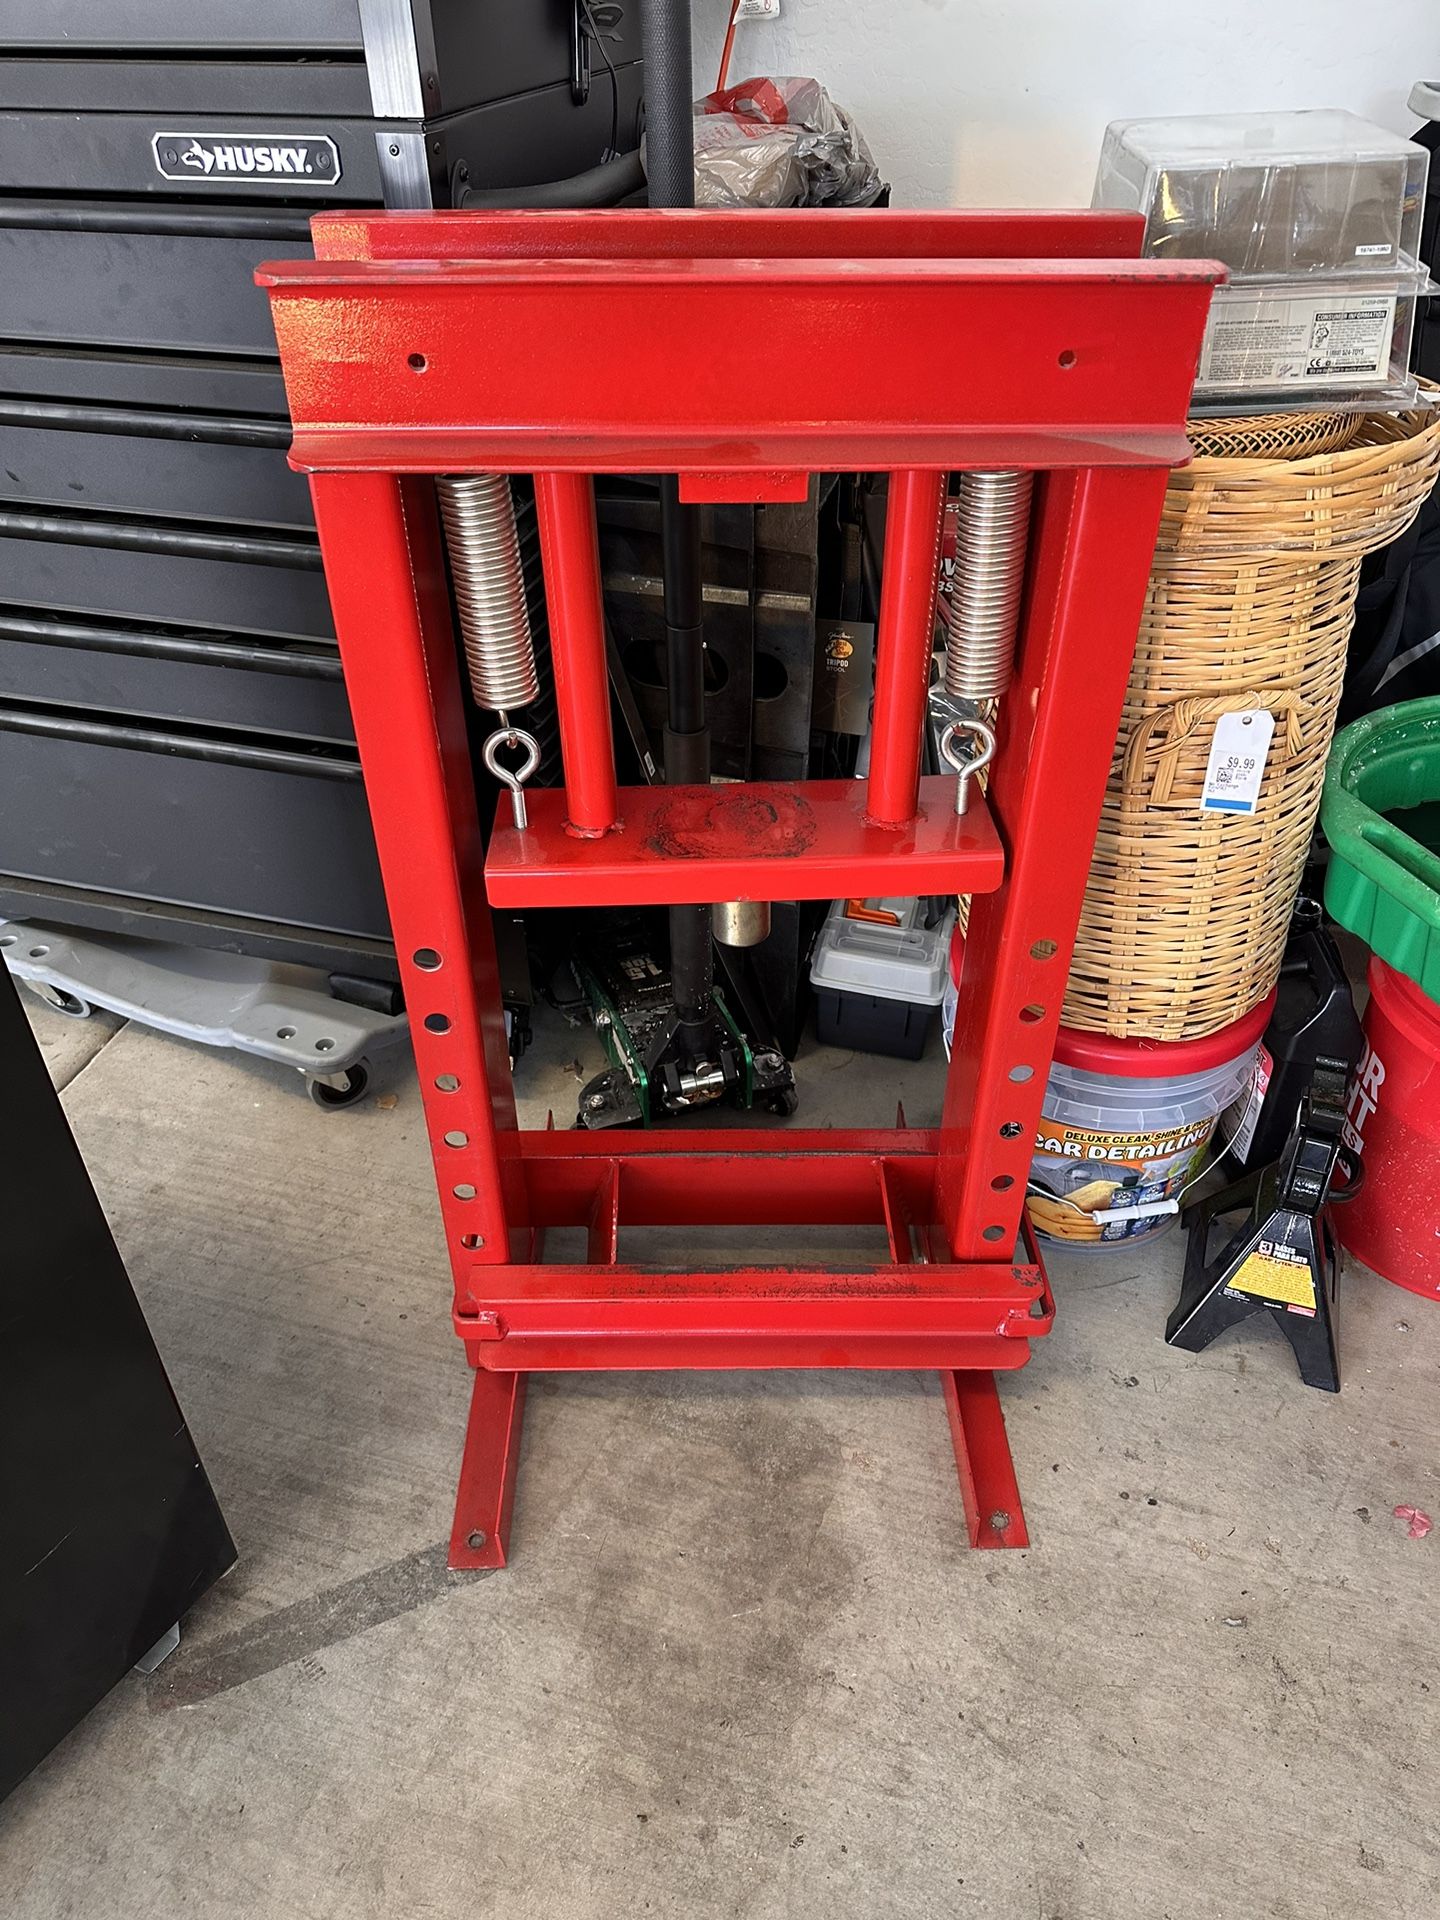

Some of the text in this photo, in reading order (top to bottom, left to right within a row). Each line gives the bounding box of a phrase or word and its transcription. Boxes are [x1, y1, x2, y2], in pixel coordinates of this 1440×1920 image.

[1349, 311, 1385, 320] INFORMATION
[826, 658, 849, 668] TRIPOD
[1227, 756, 1255, 770] $9.99
[1065, 1131, 1111, 1144] DELUXE
[1112, 1132, 1153, 1145] CLEAN,
[1154, 1127, 1182, 1141] SHINE
[1088, 1123, 1208, 1160] DETAILING
[1273, 1251, 1308, 1264] PARA GATO
